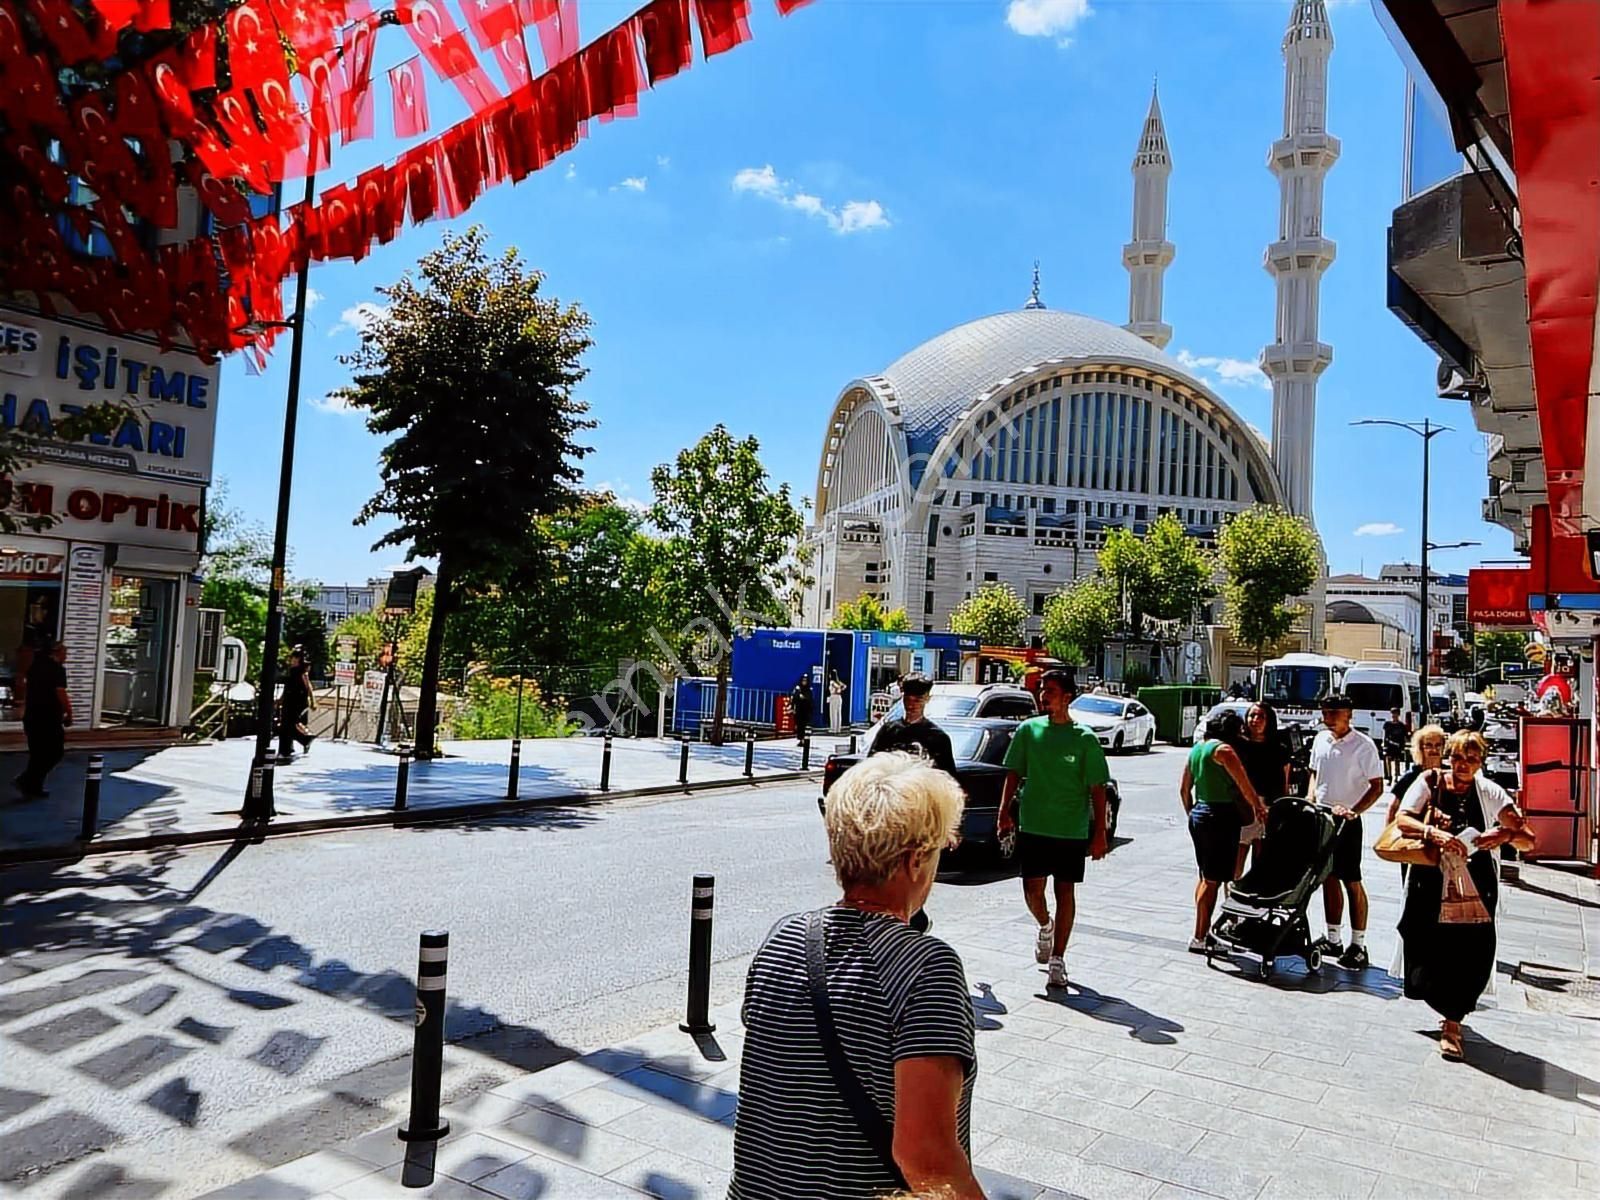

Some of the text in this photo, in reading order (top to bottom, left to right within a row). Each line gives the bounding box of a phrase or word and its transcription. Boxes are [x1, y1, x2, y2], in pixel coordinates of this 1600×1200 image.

[0, 325, 37, 351] ES
[56, 335, 209, 409] İŞİTME
[67, 488, 200, 533] OPTİK
[1496, 609, 1526, 617] DÖNER
